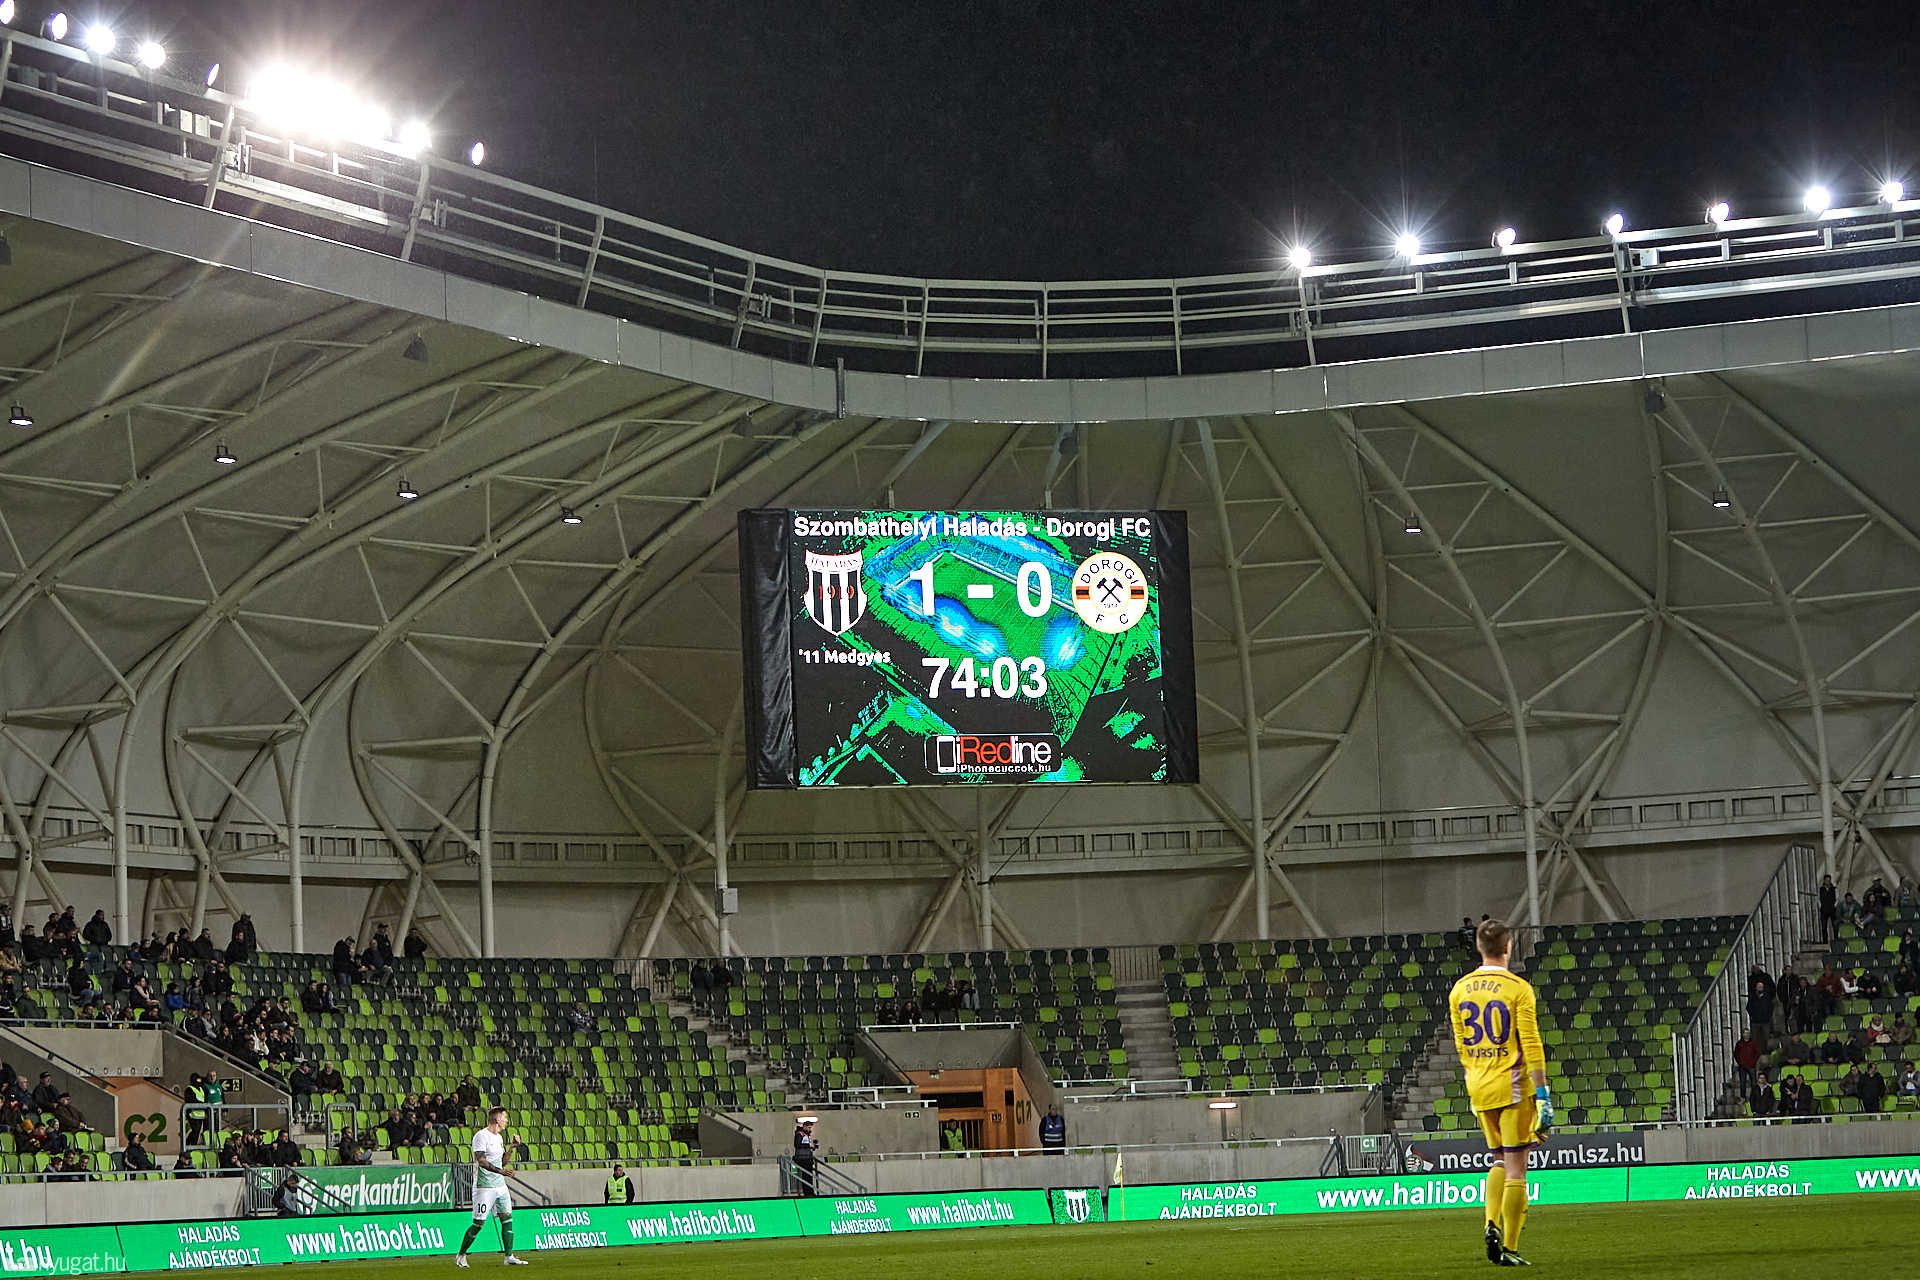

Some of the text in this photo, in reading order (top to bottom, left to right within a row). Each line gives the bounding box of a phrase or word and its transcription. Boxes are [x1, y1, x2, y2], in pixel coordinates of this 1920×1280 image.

[794, 517, 937, 541] Szombathelyi
[943, 516, 1027, 537] Haladás
[1047, 517, 1116, 541] Dorogi
[1122, 517, 1151, 537] FC
[1080, 559, 1140, 585] DOROGI
[910, 561, 1053, 618] 1 - 0
[825, 650, 891, 666] Medgyes
[921, 657, 1048, 699] 74:03
[1466, 980, 1502, 994] DOROG
[1458, 1000, 1511, 1046] 30
[124, 1112, 168, 1143] C2
[1362, 1137, 1376, 1149] C1
[1439, 1142, 1644, 1170] meccgy.mlsz.hu
[1706, 1162, 1790, 1181] HALADÁS
[322, 1171, 452, 1209] merkantilbank
[1181, 1182, 1257, 1201] HALADÁS
[1316, 1178, 1540, 1208] www.halibolu
[1684, 1182, 1812, 1200] AJÁNDÉKBOLT
[477, 1203, 487, 1214] 10
[834, 1196, 877, 1214] HALADÁS
[907, 1197, 1014, 1225] www.halibolt.hu
[1159, 1201, 1278, 1220] AJÁNDÉKBOLT
[541, 1207, 591, 1228] HALADÁS
[626, 1207, 756, 1239] www.halibolt.hu
[830, 1215, 893, 1234] AJÁNDÉKBOLT
[177, 1221, 241, 1244] HALADÁS
[286, 1221, 444, 1256] www.halibolt.hu
[534, 1228, 608, 1250] AJÁNDÉKBOLT
[168, 1245, 262, 1270] AJÁNDÉKBOLT
